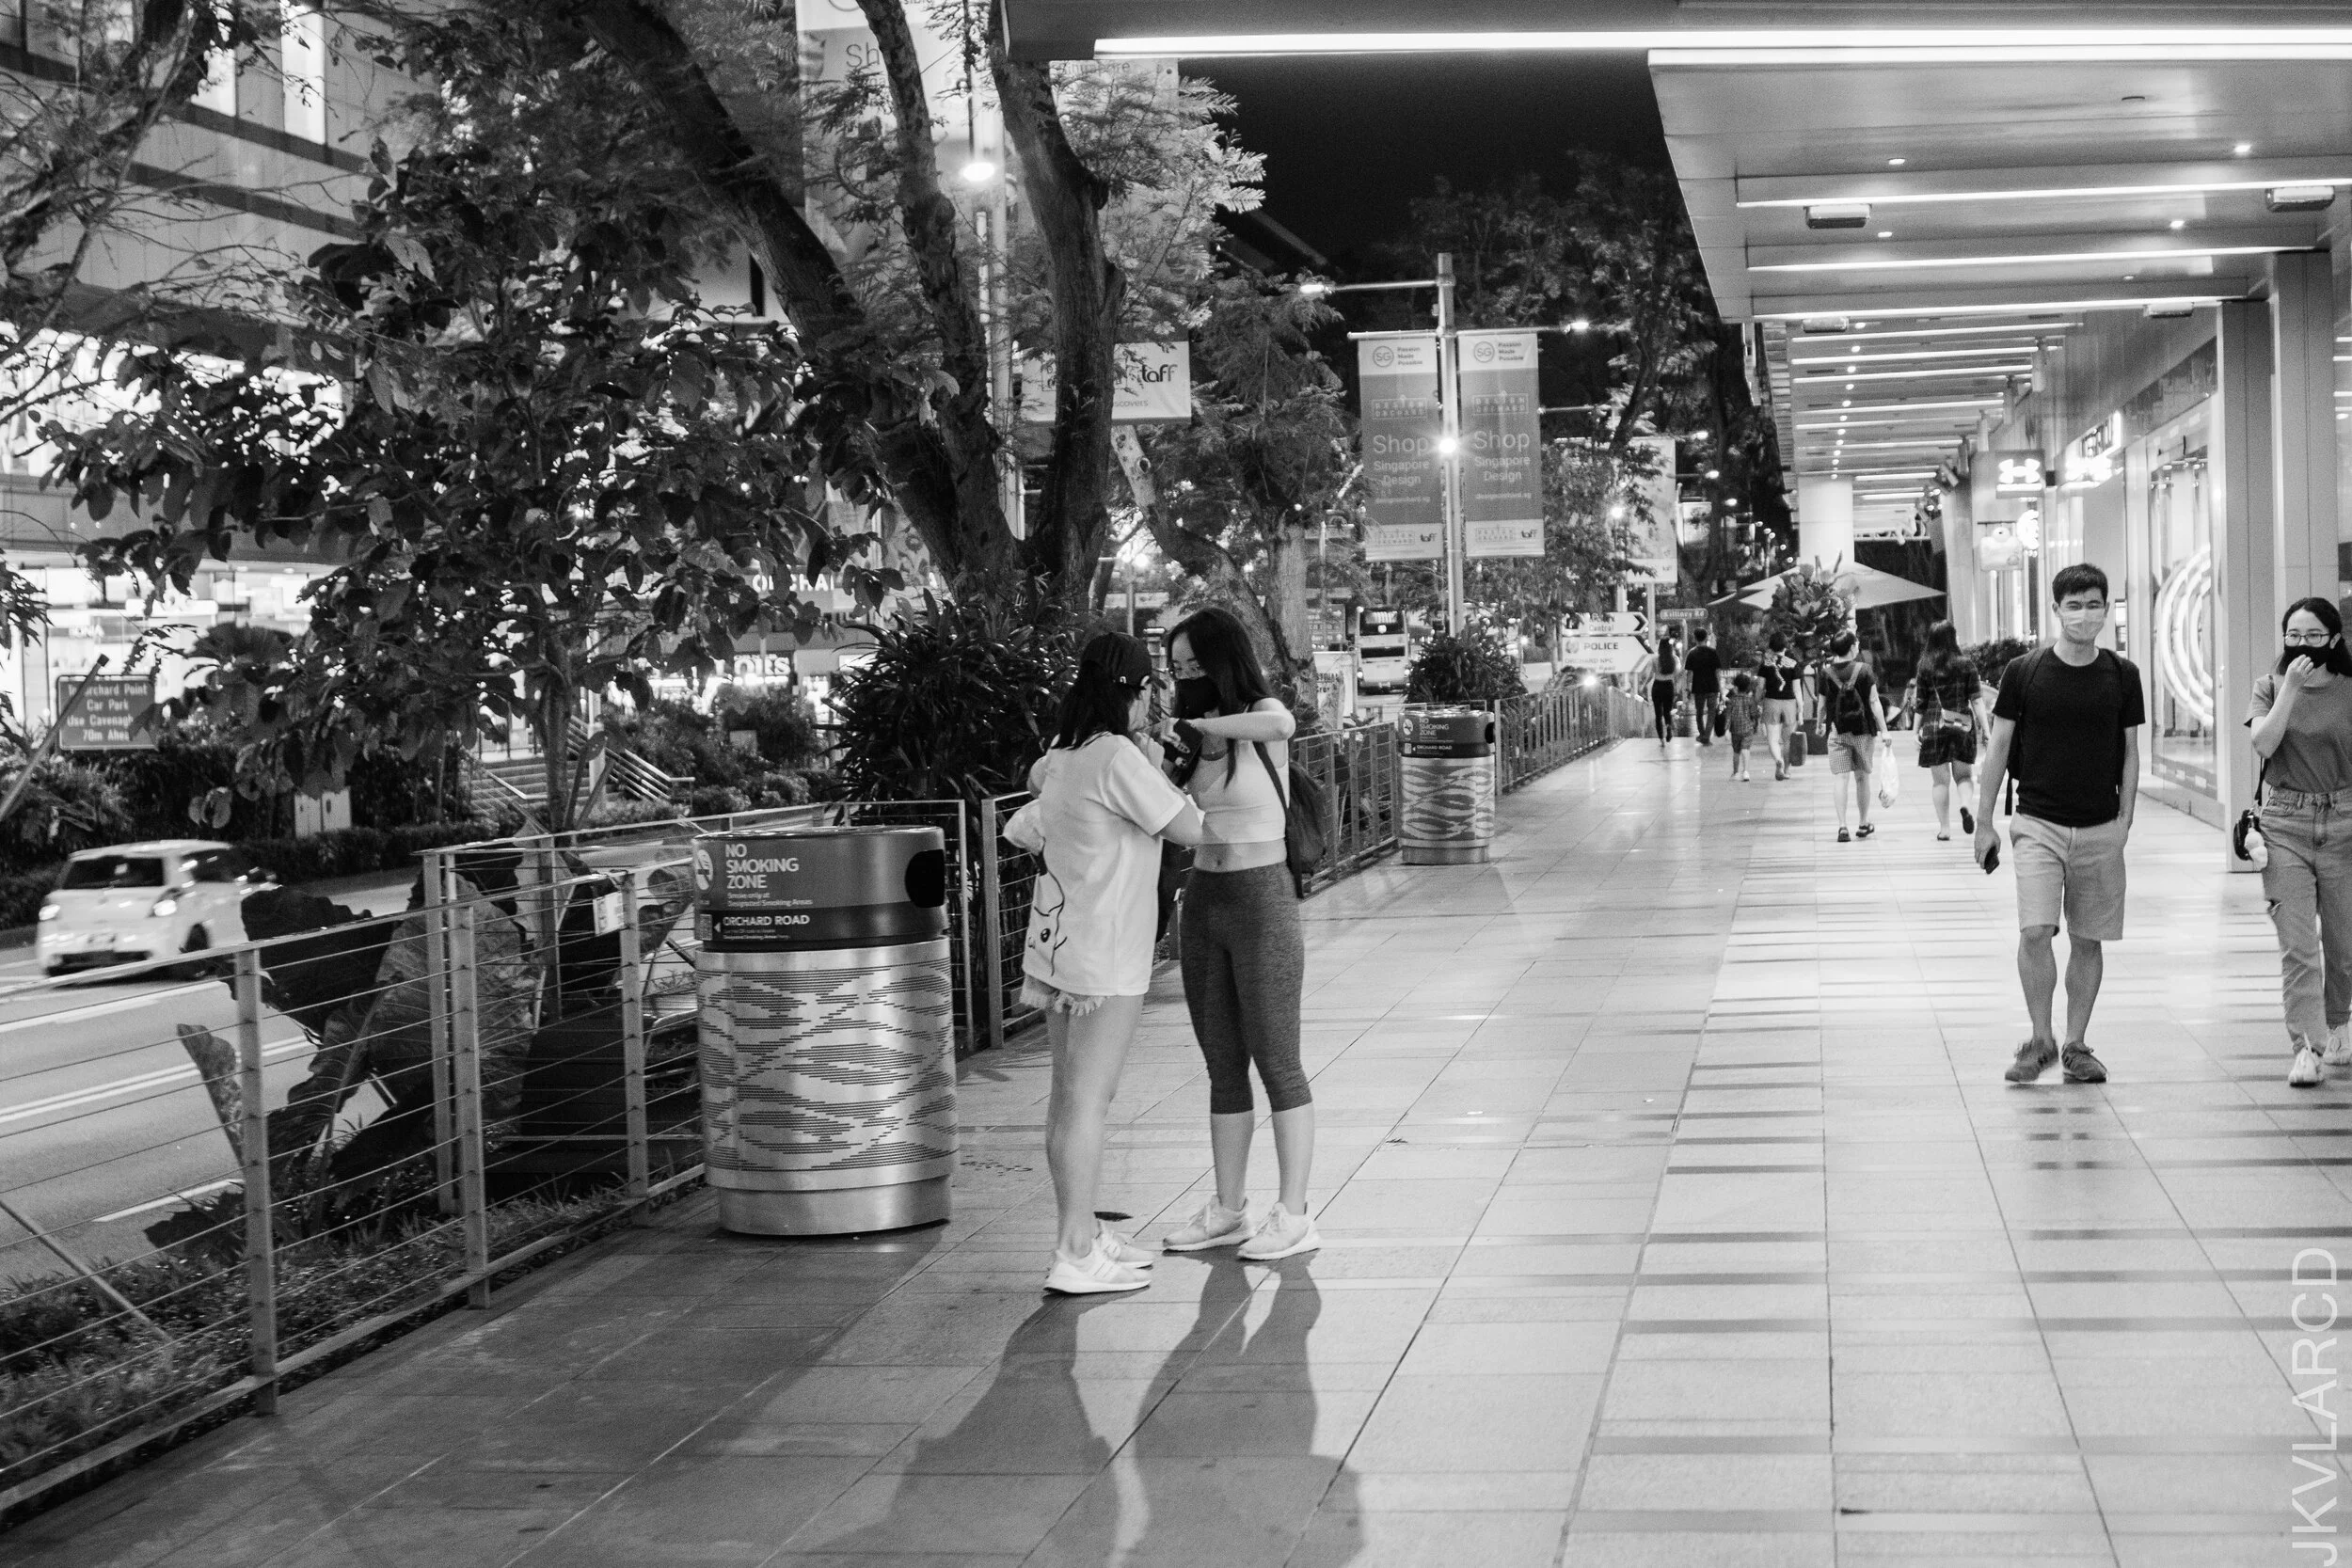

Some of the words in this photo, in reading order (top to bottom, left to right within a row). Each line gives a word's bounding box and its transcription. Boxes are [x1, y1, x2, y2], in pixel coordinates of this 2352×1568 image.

[1141, 363, 1178, 383] taff
[1373, 434, 1429, 456] Shop
[1473, 430, 1531, 452] Shop
[1374, 459, 1430, 472] Singapore
[1474, 455, 1532, 468] Singapore
[1383, 474, 1422, 486] Design
[1484, 470, 1522, 483] Design
[1583, 641, 1619, 650] POLICE
[124, 684, 148, 696] Point
[87, 699, 103, 710] Car
[108, 699, 129, 710] Park
[67, 715, 85, 726] Use
[83, 730, 103, 741] 70m
[725, 844, 747, 858] NO
[725, 857, 800, 874] SMOKING
[726, 874, 768, 889] ZONE
[723, 916, 772, 927] ORCHARD
[774, 914, 810, 926] ROAD
